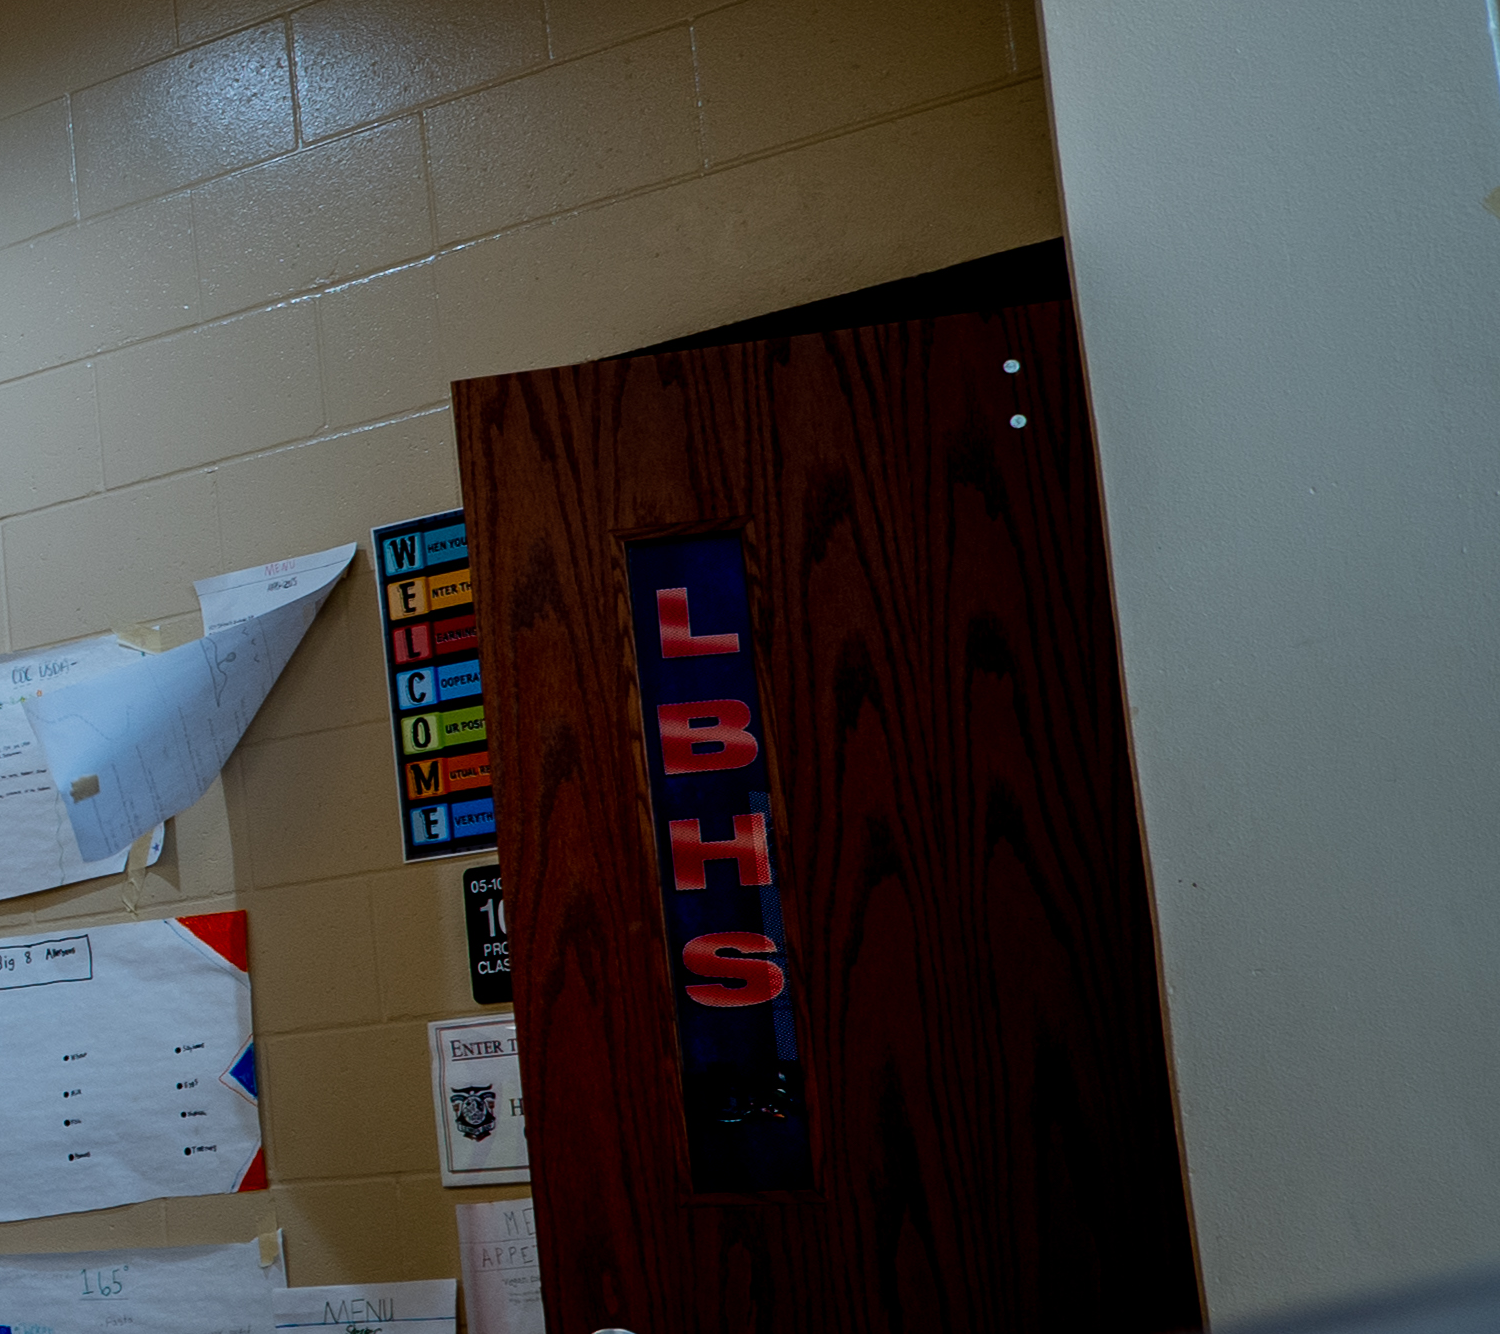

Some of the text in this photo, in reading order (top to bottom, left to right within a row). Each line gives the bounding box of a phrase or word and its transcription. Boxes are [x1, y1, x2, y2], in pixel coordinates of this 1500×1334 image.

[24, 951, 33, 964] 8
[450, 1037, 504, 1058] ENTER
[323, 1298, 394, 1324] MENU
